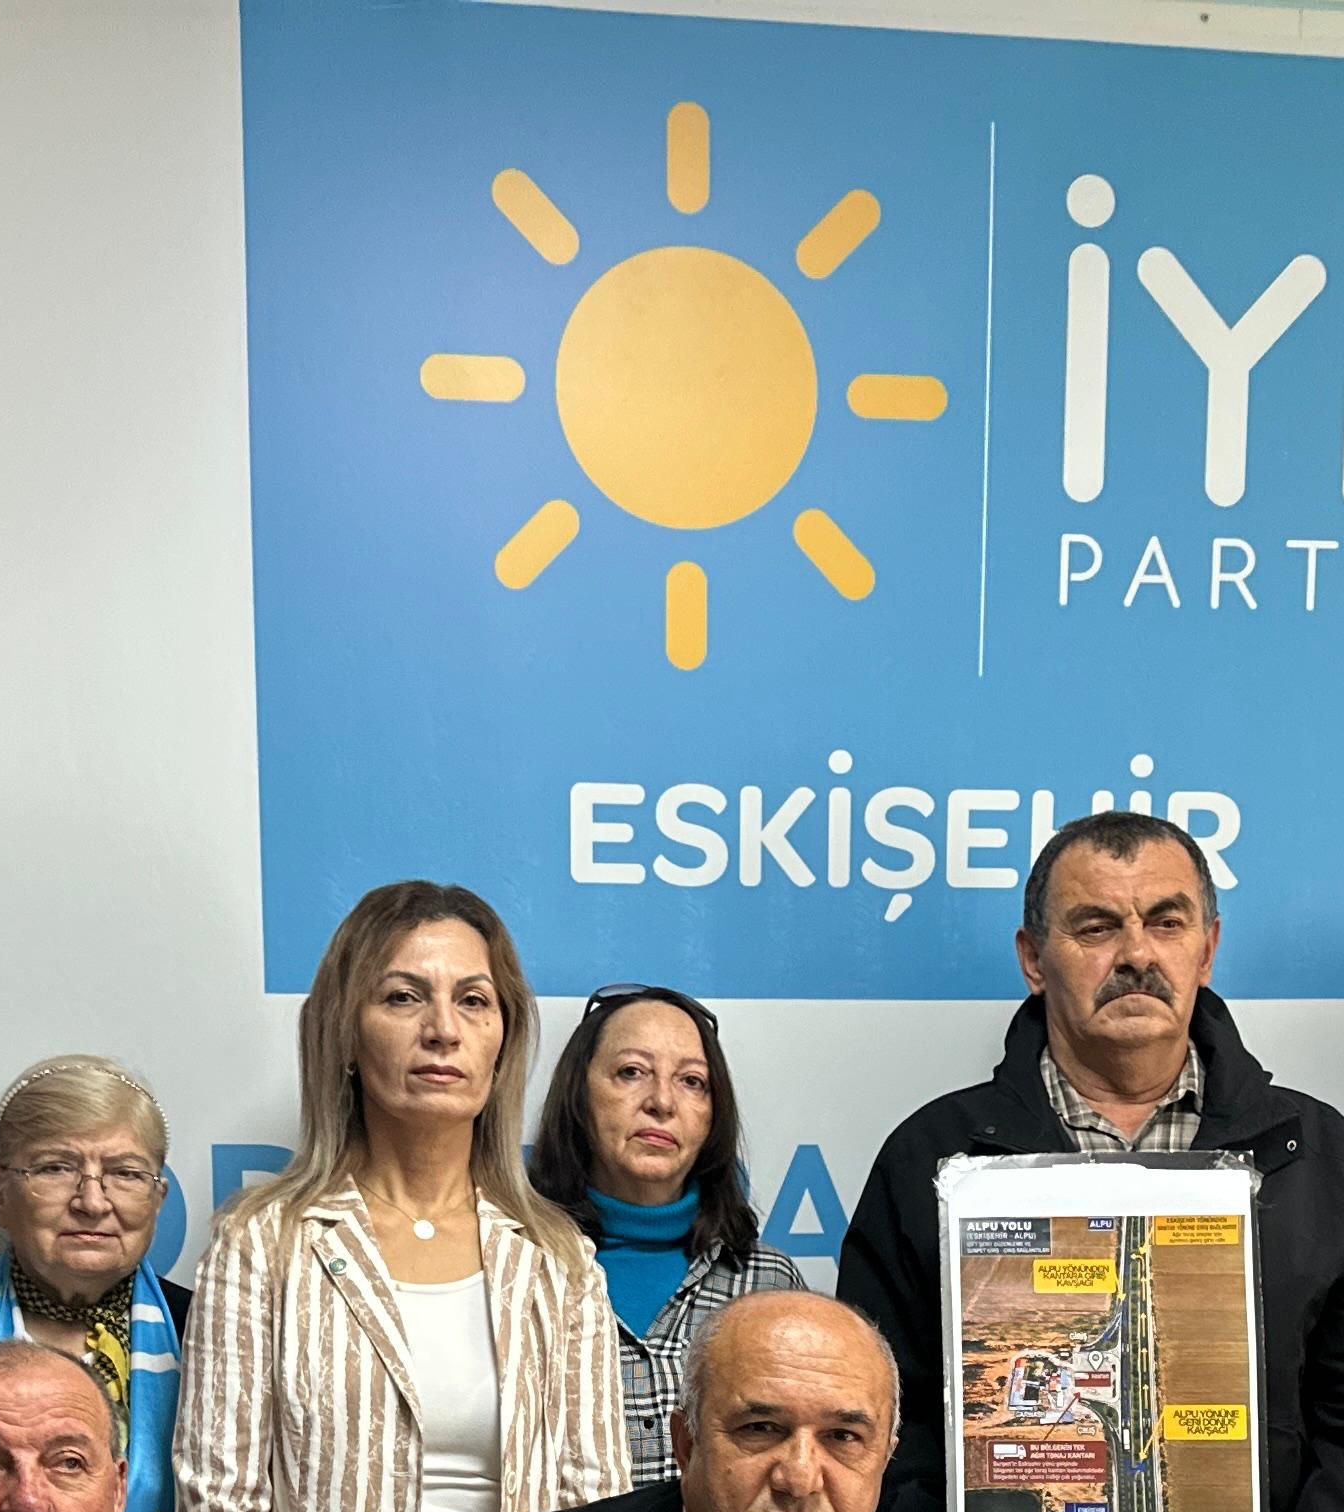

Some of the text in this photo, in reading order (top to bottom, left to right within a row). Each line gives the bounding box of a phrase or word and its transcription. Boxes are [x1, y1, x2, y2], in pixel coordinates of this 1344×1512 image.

[967, 1221, 1032, 1231] ALPU YOLU
[1089, 1220, 1112, 1228] ALPU
